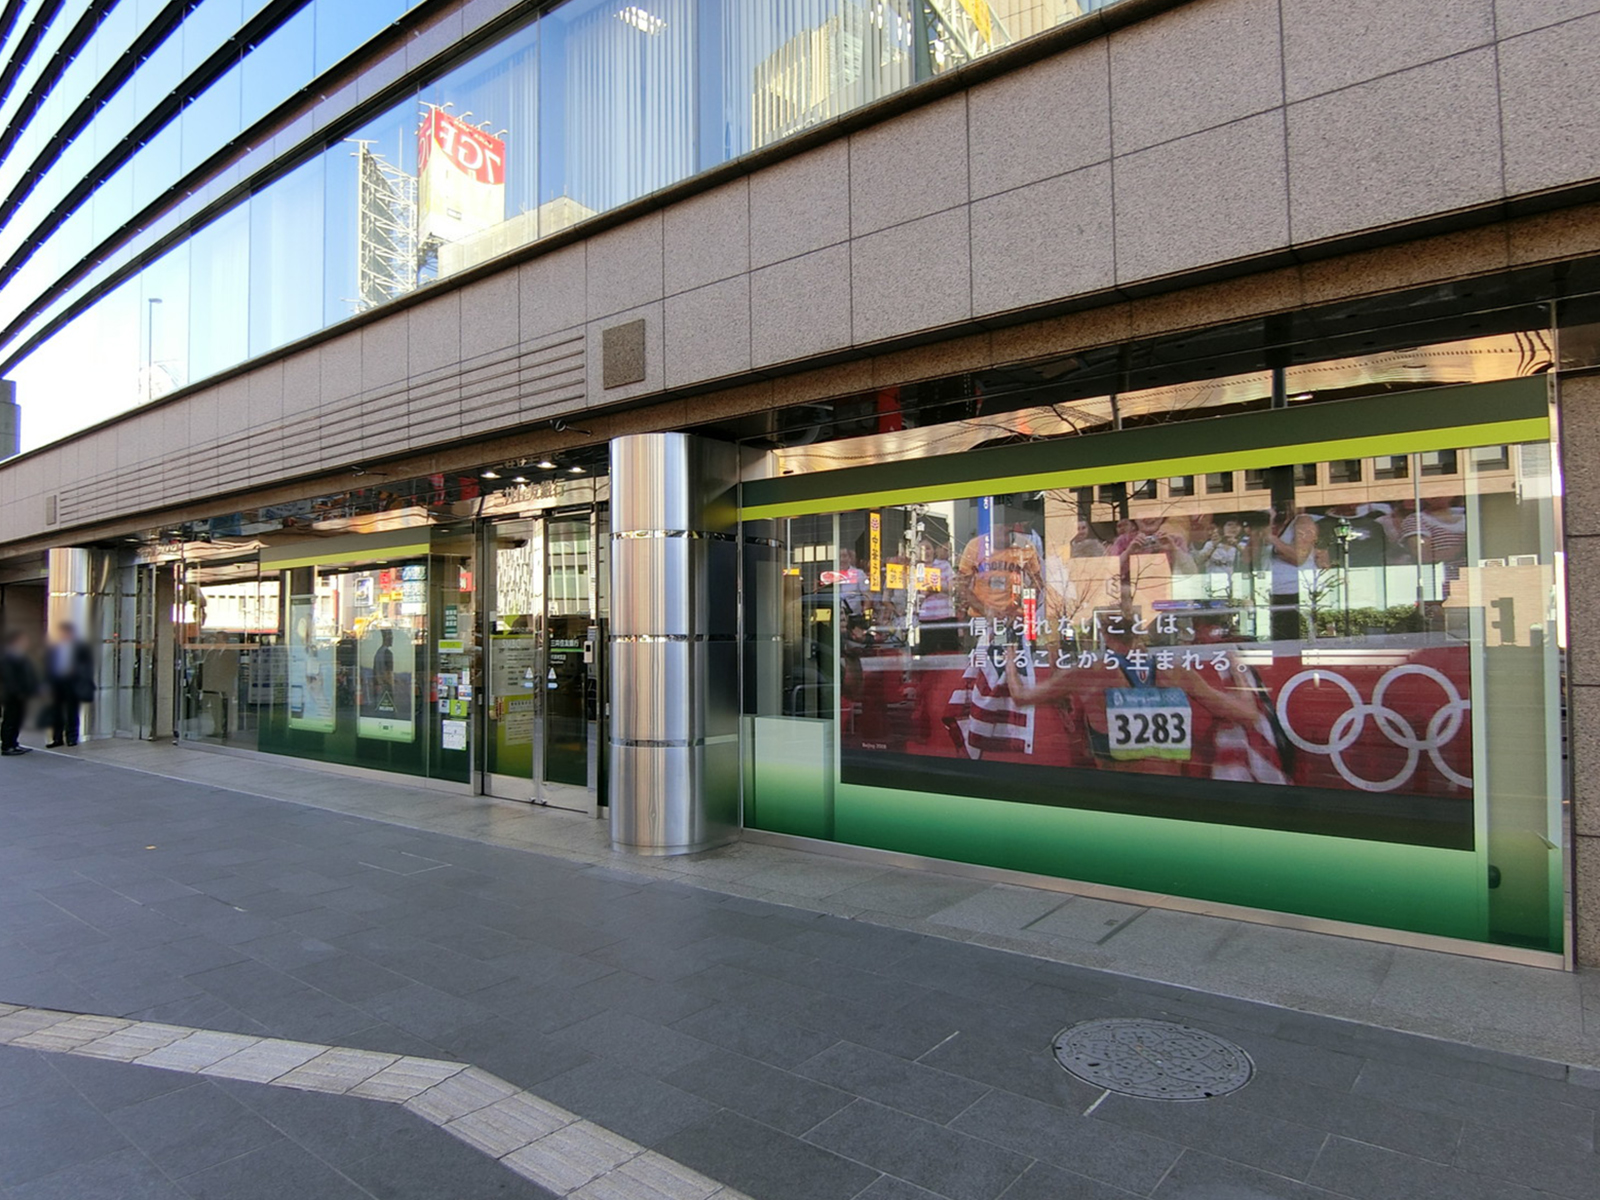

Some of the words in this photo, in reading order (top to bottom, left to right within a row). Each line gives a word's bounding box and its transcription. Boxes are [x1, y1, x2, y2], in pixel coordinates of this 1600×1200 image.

[967, 615, 1196, 637] 信じられないことは、
[967, 650, 1250, 673] 信じることから生まれる。
[1115, 712, 1186, 745] 3283
